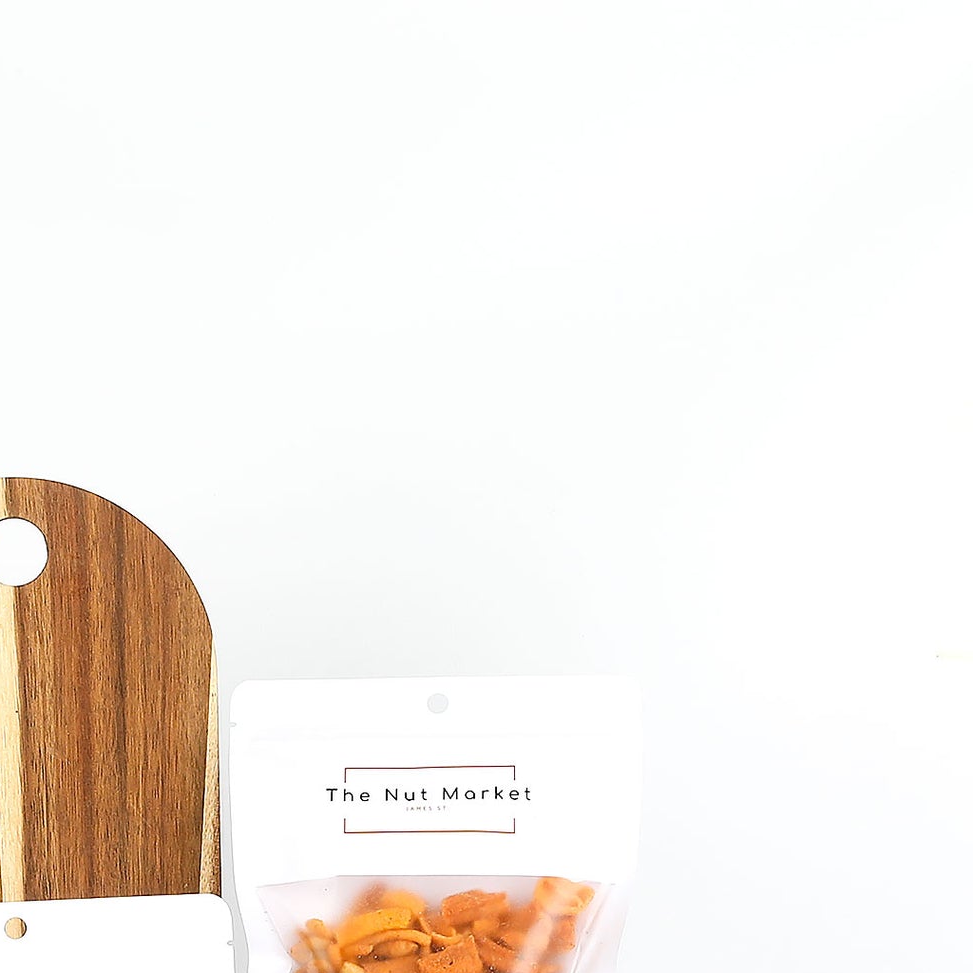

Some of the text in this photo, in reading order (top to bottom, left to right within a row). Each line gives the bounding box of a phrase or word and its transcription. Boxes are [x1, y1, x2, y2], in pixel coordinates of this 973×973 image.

[326, 786, 531, 802] The Nut Market
